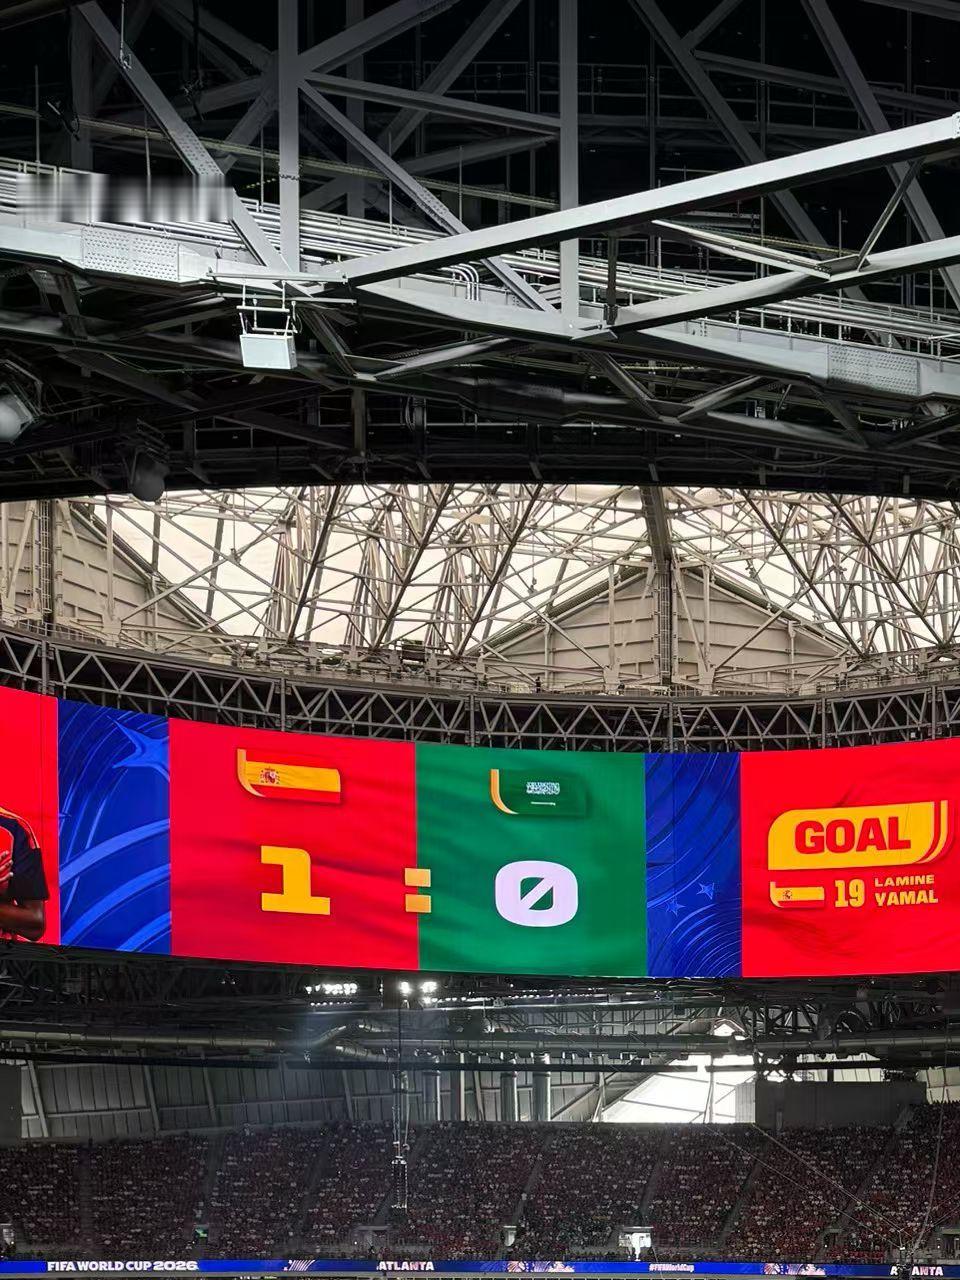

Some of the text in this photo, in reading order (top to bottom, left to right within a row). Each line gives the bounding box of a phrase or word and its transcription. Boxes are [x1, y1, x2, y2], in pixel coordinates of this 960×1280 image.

[794, 816, 912, 854] GOAL
[261, 846, 331, 915] 1
[495, 860, 578, 928] 0
[874, 874, 935, 888] LAMINE
[834, 878, 866, 908] 19
[874, 889, 939, 907] YAMAL
[47, 1260, 198, 1271] FIFA WORLD CUP 2026
[380, 1261, 435, 1271] ATLANTA
[890, 1265, 944, 1276] AANTA
